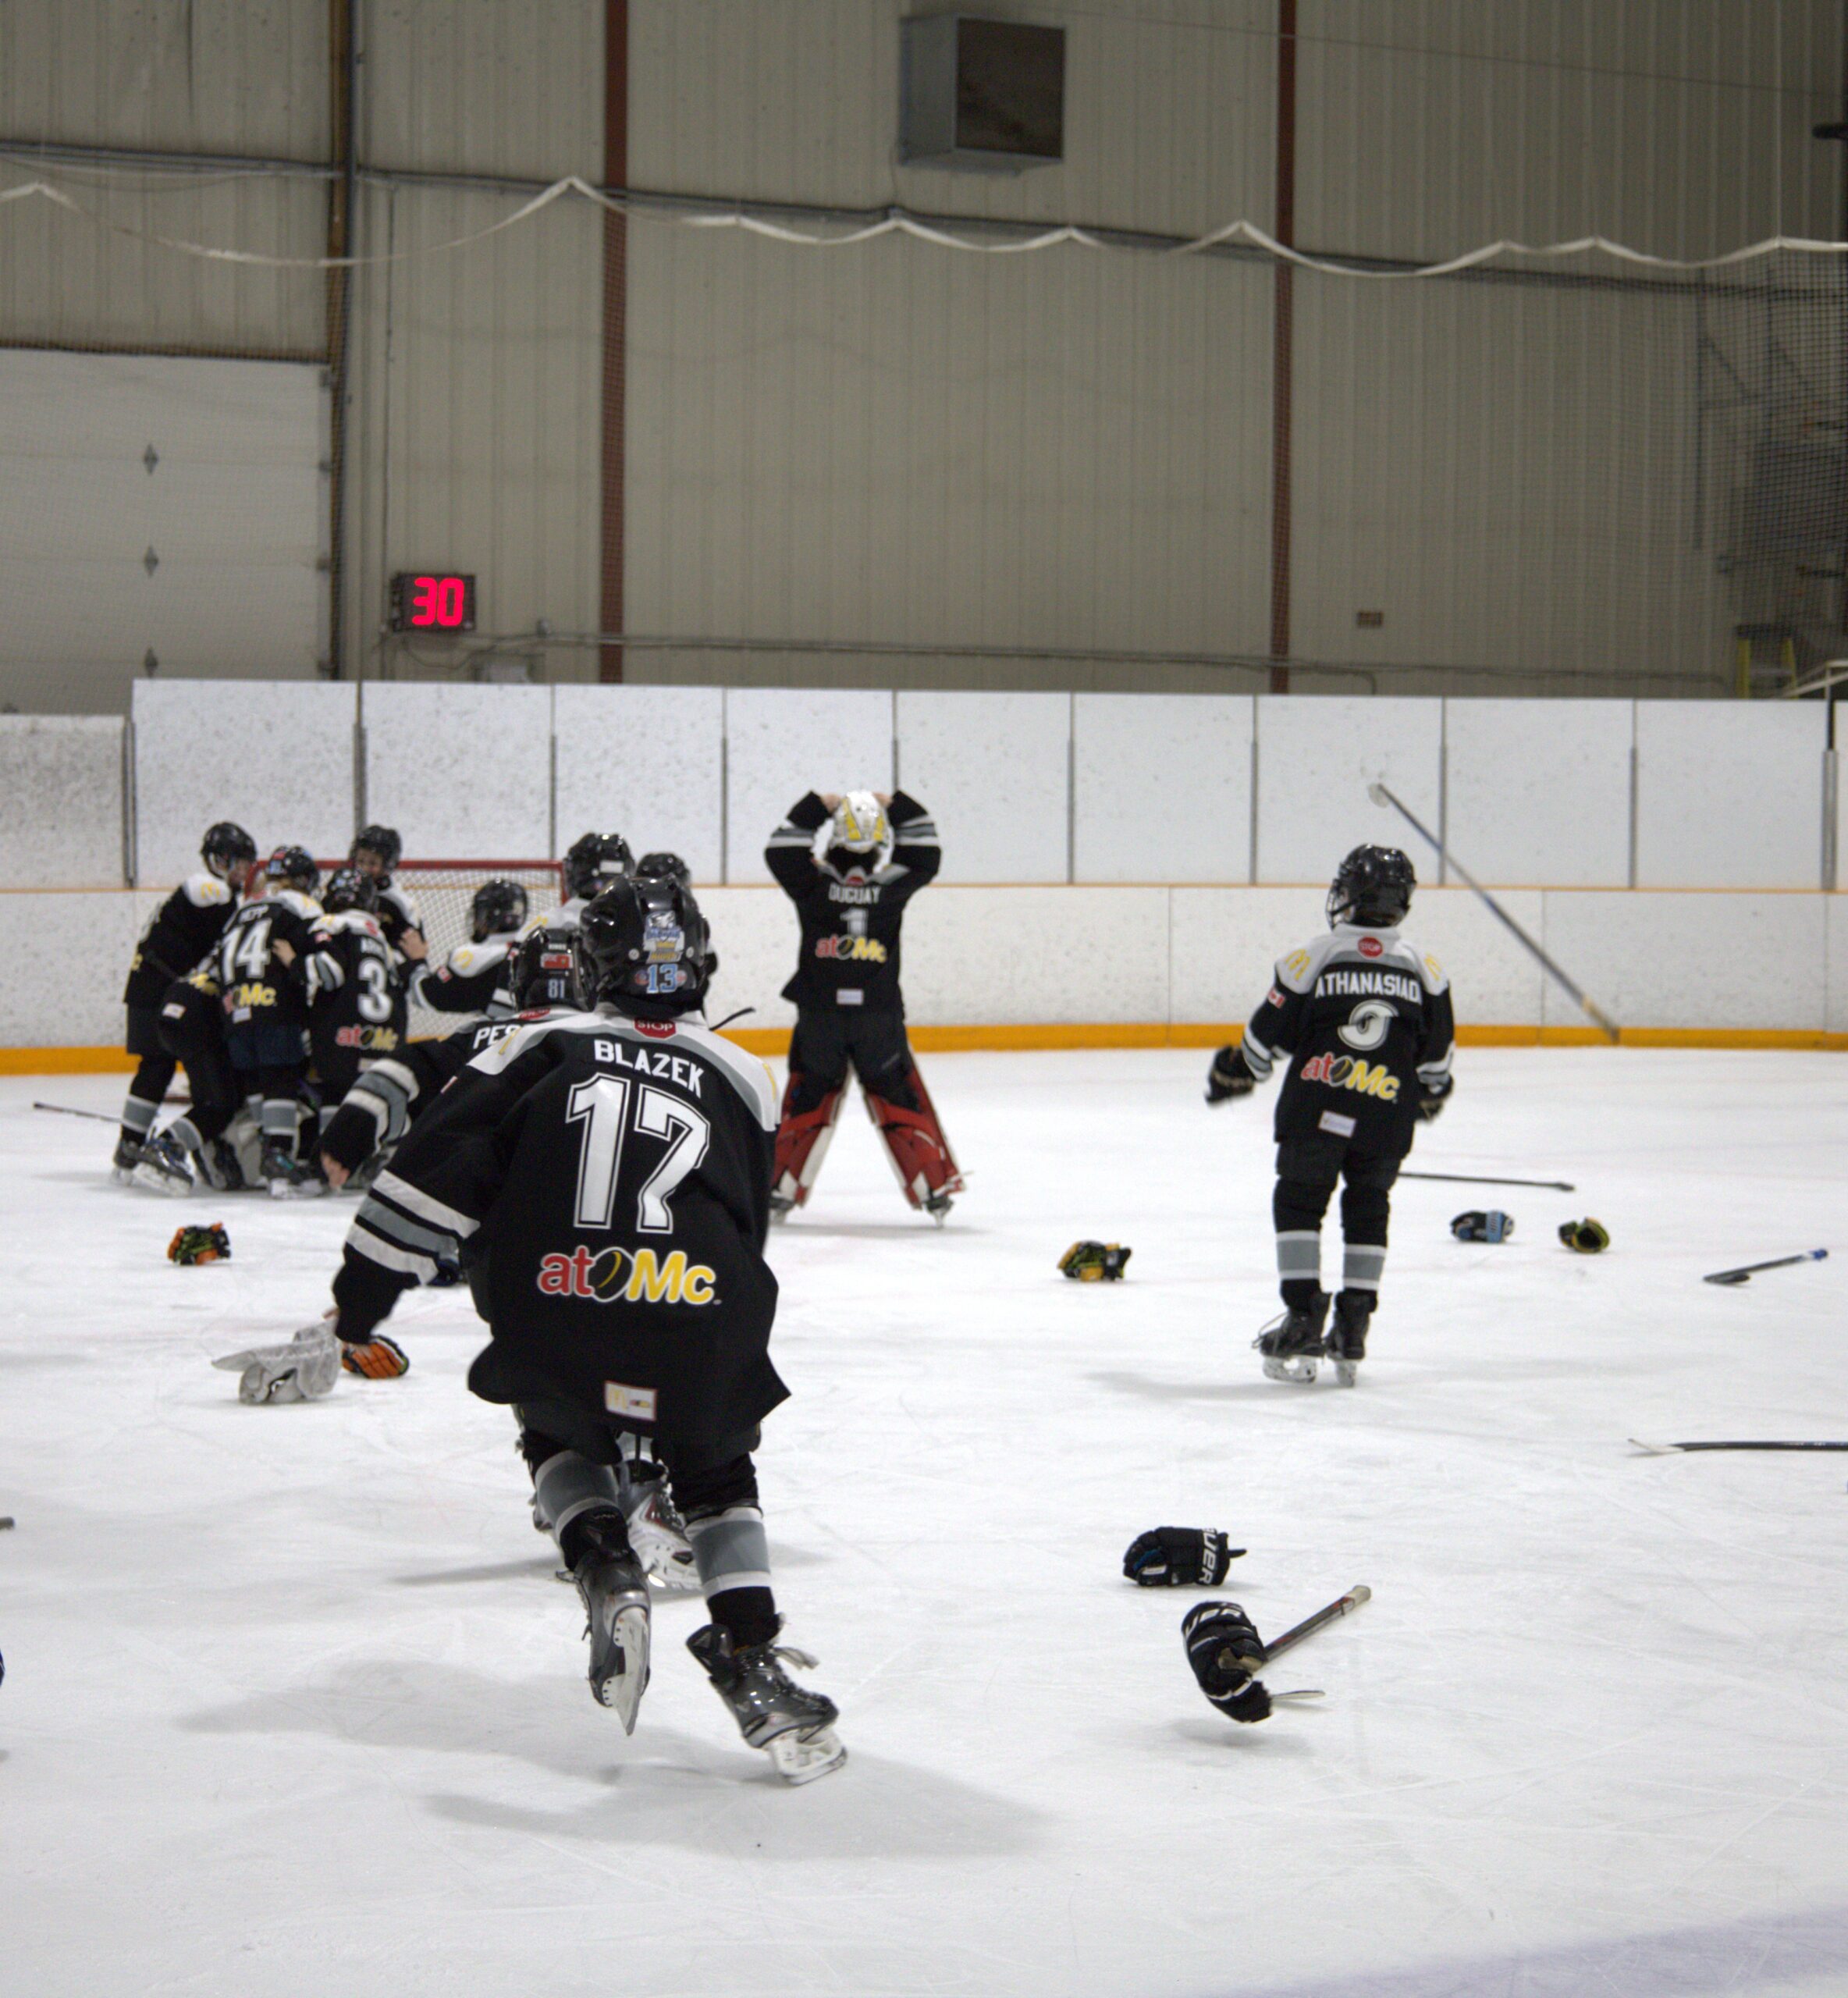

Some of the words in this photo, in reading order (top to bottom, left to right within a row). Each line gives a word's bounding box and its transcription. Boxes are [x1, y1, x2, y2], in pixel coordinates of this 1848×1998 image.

[412, 577, 464, 626] 30
[840, 906, 869, 936] 1
[222, 918, 273, 985] 14
[646, 963, 678, 994] 13
[357, 957, 394, 1024] 3
[548, 979, 566, 998] 81
[594, 1040, 705, 1099] BLAZEK
[565, 1072, 710, 1234] 17
